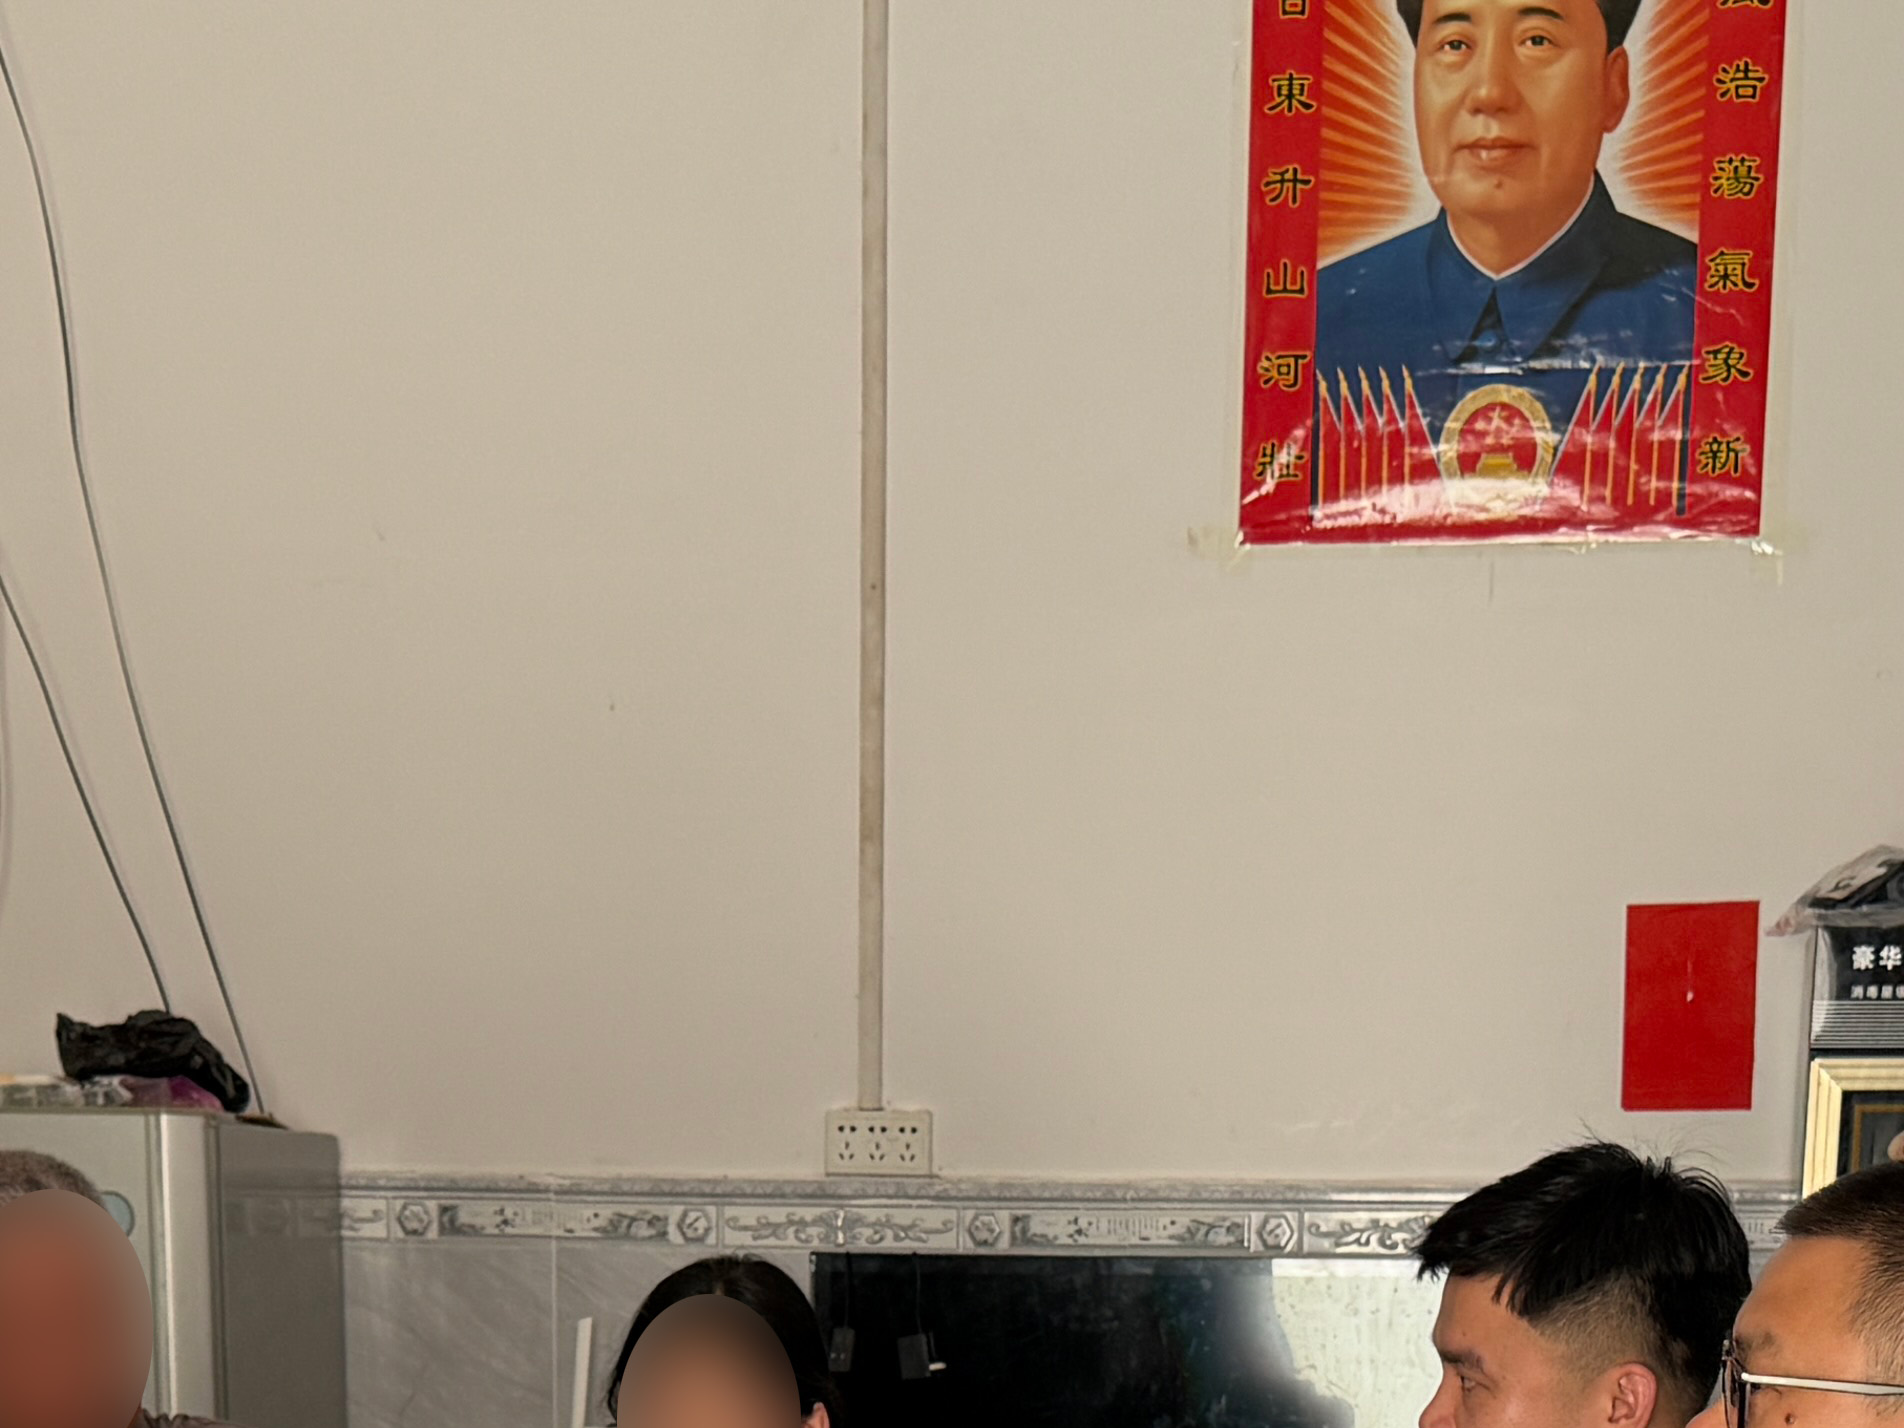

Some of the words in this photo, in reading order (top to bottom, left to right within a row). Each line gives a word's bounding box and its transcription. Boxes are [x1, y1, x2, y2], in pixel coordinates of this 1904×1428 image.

[1697, 0, 1772, 476] 浩蕩氣象新
